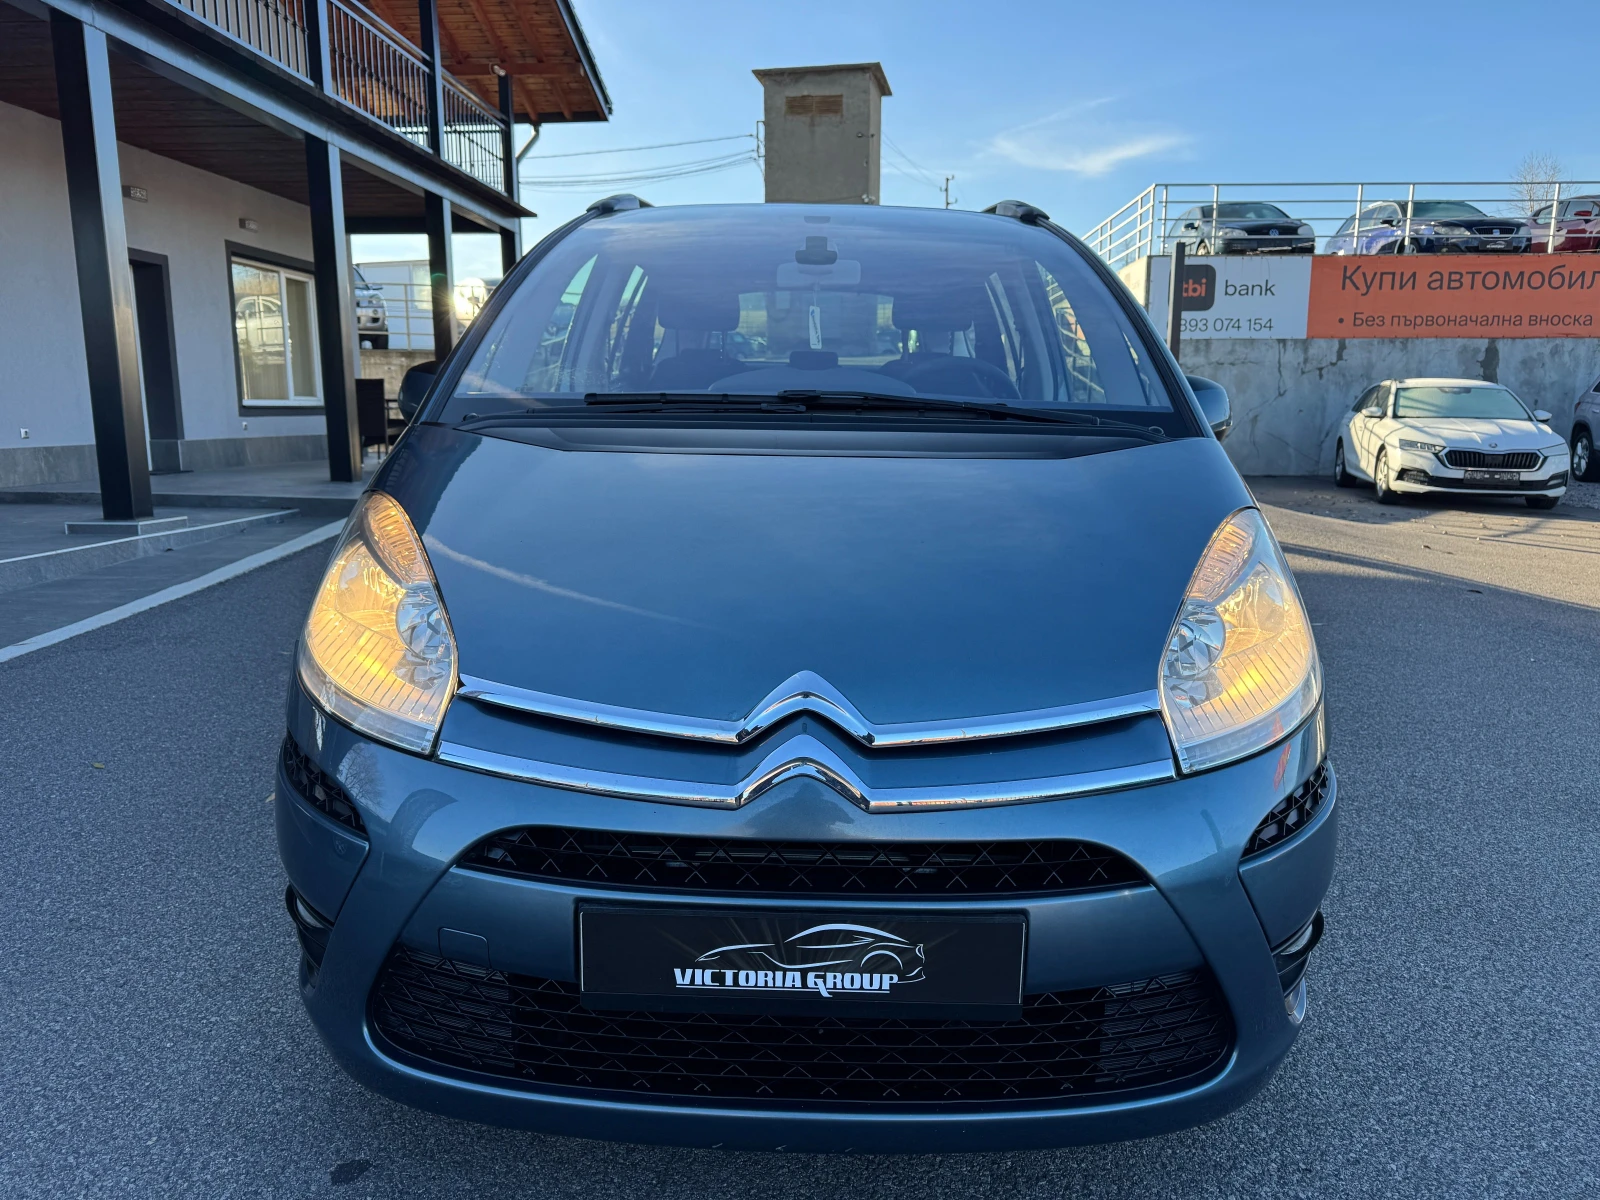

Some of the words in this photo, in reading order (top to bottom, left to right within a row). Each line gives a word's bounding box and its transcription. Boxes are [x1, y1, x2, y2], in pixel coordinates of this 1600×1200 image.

[1224, 279, 1276, 297] bank
[1341, 265, 1417, 297] Купи
[1427, 264, 1600, 291] автомобил
[1178, 317, 1209, 333] 893
[1213, 317, 1242, 332] 074
[1246, 317, 1274, 332] 154
[1353, 312, 1386, 327] Без
[1390, 314, 1523, 330] първоначална
[1528, 314, 1593, 327] вноска
[673, 968, 802, 988] VICTORIA
[806, 971, 899, 998] GROUP
